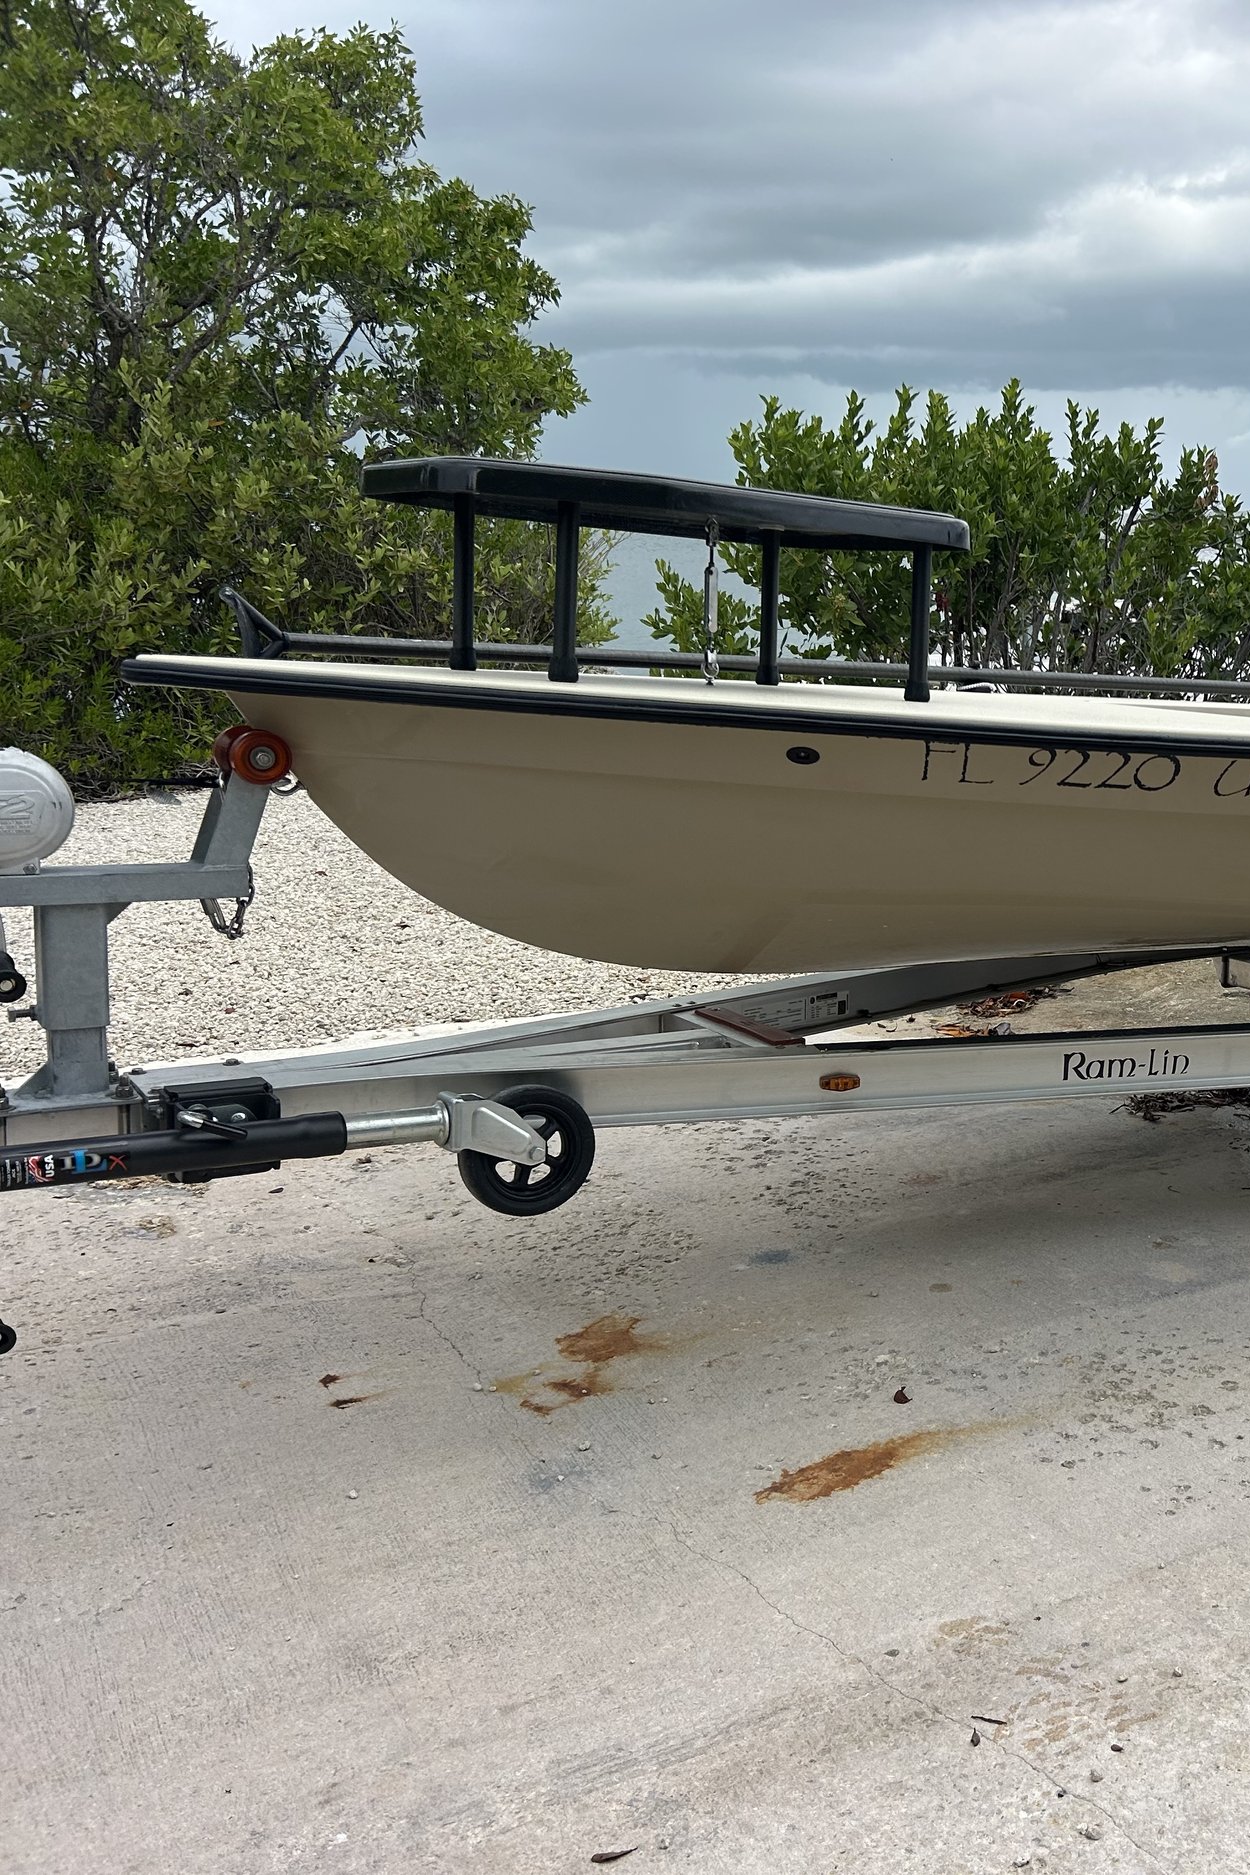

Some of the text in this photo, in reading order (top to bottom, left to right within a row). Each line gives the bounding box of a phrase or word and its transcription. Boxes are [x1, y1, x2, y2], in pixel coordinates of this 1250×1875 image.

[921, 740, 994, 784] FL
[1018, 748, 1181, 791] 9220
[1062, 1048, 1190, 1081] Ram-Lin
[44, 1155, 55, 1178] USA
